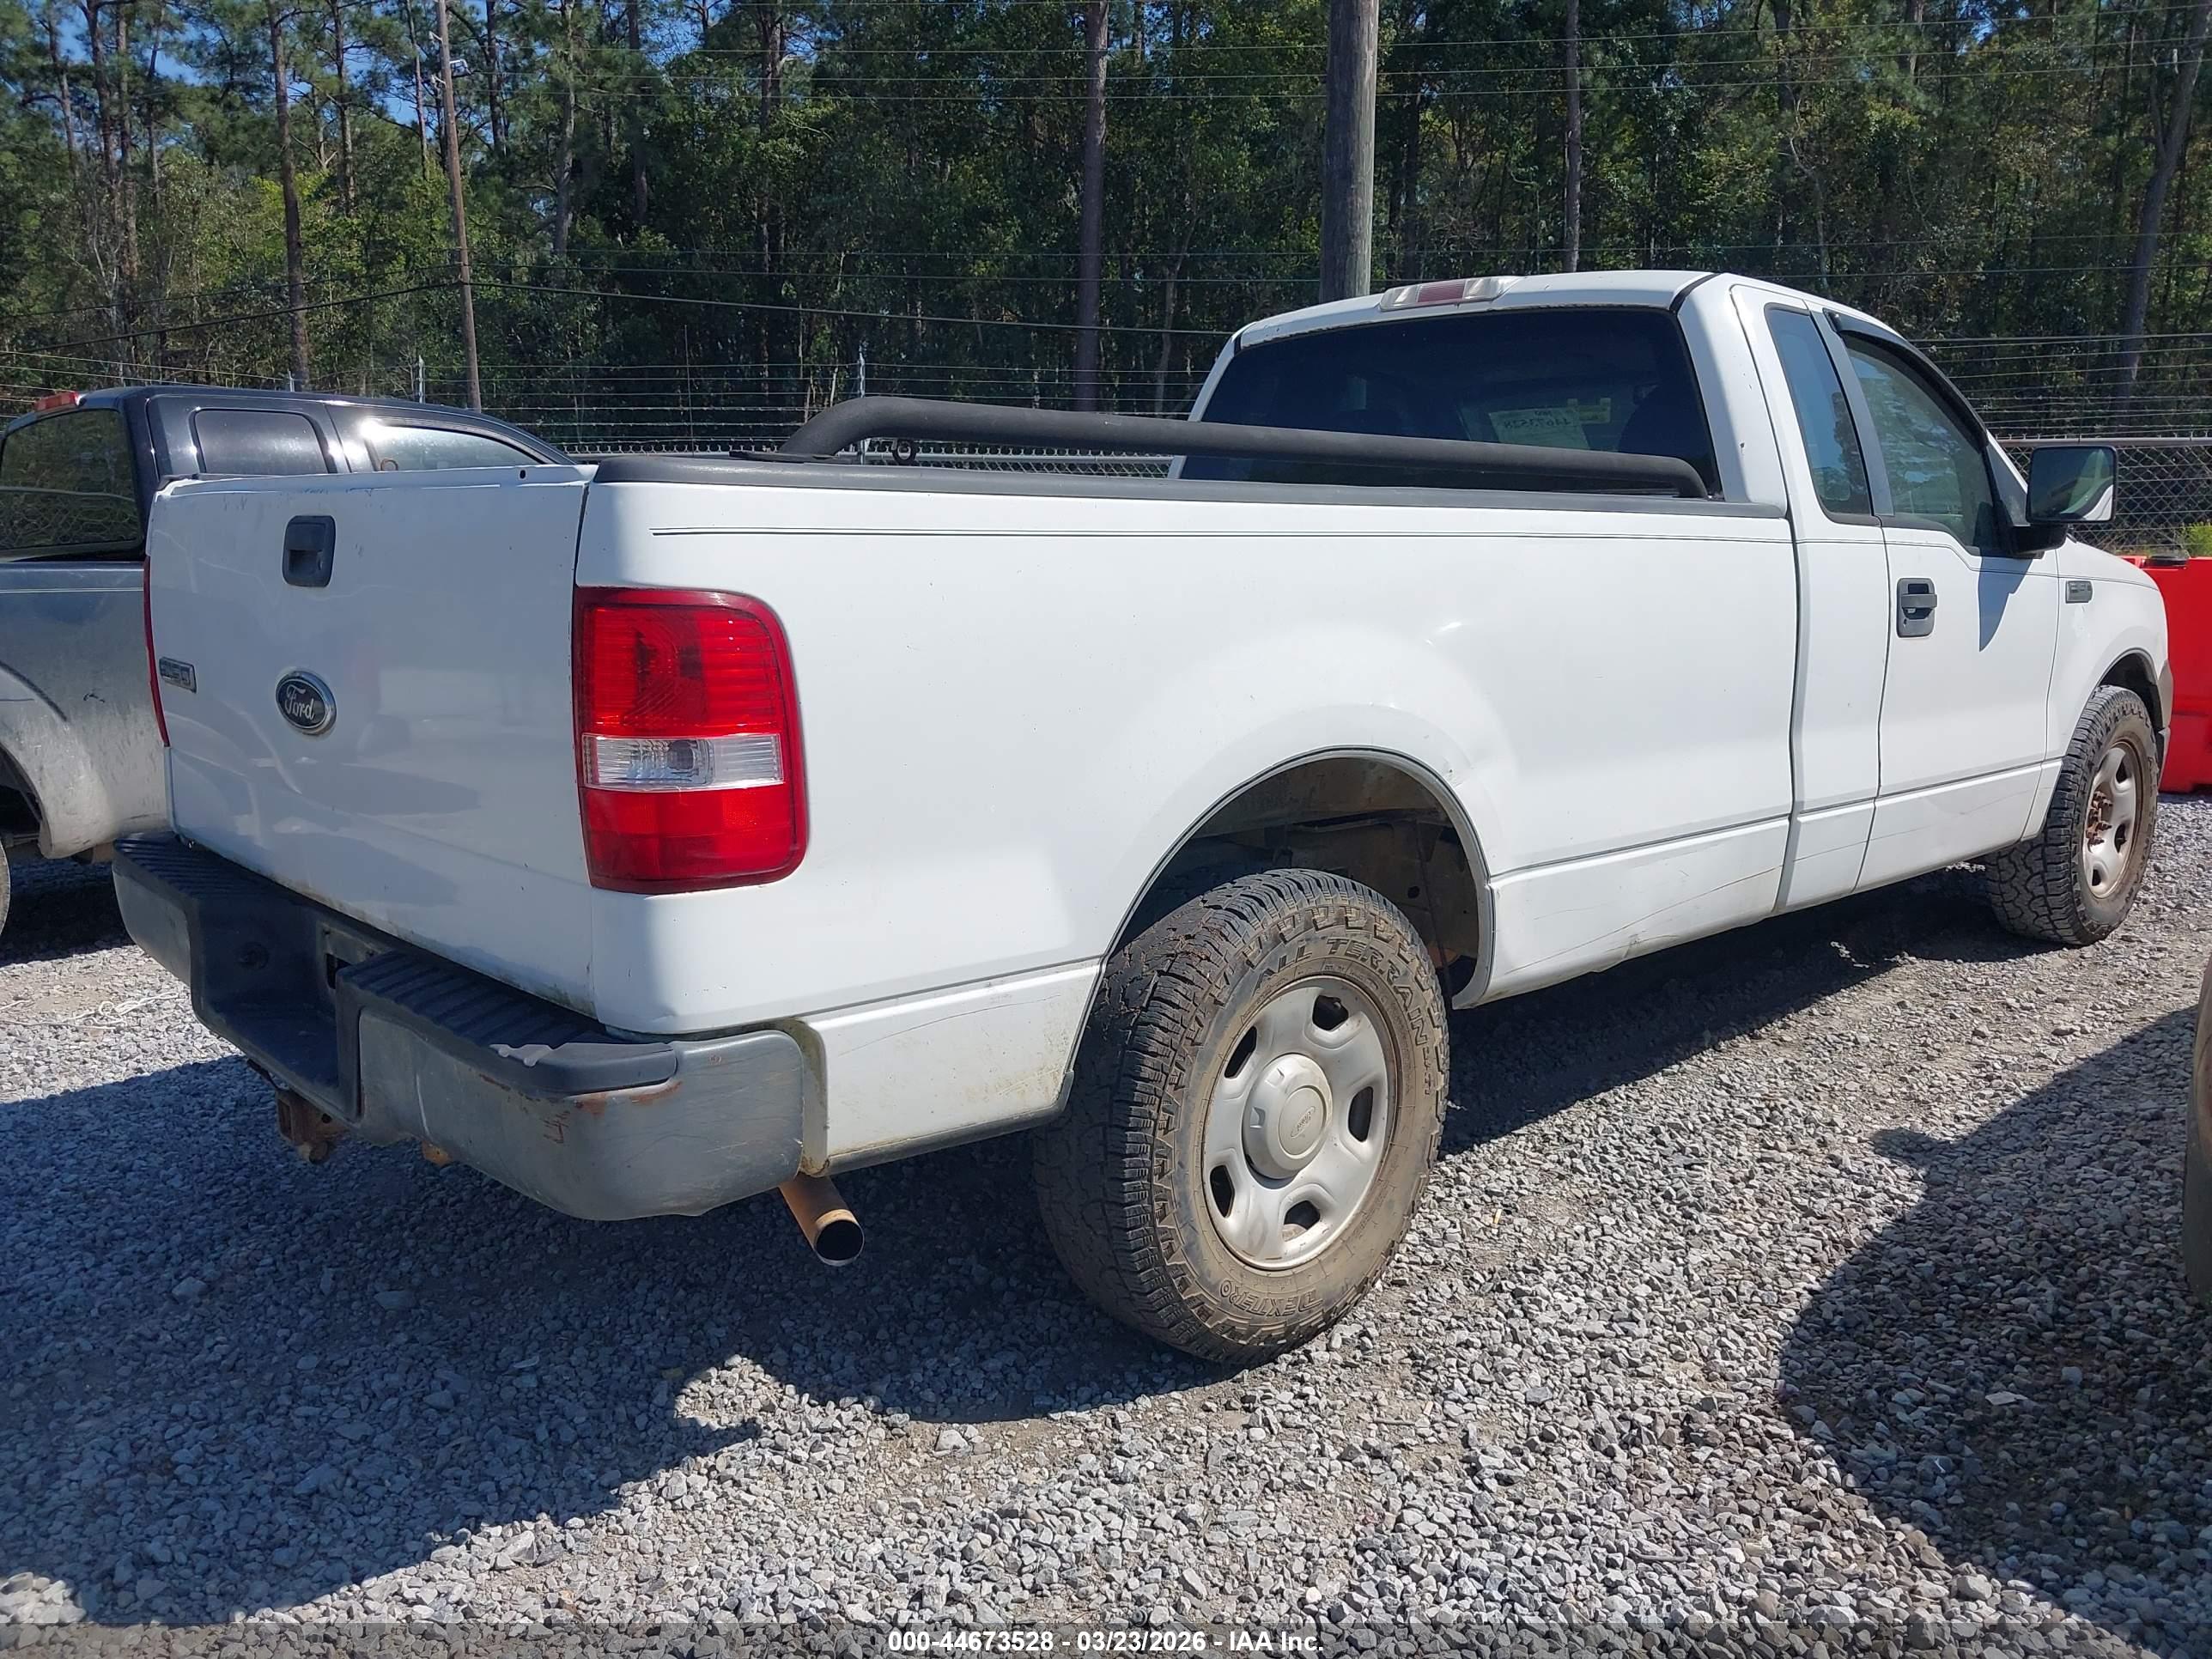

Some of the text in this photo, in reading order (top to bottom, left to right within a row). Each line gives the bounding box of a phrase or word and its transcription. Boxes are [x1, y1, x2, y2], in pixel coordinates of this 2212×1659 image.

[284, 684, 315, 720] Ford
[1252, 945, 1313, 996] ALL
[1327, 937, 1429, 1046] TERRAIN
[1219, 1279, 1323, 1317] DEXTERO
